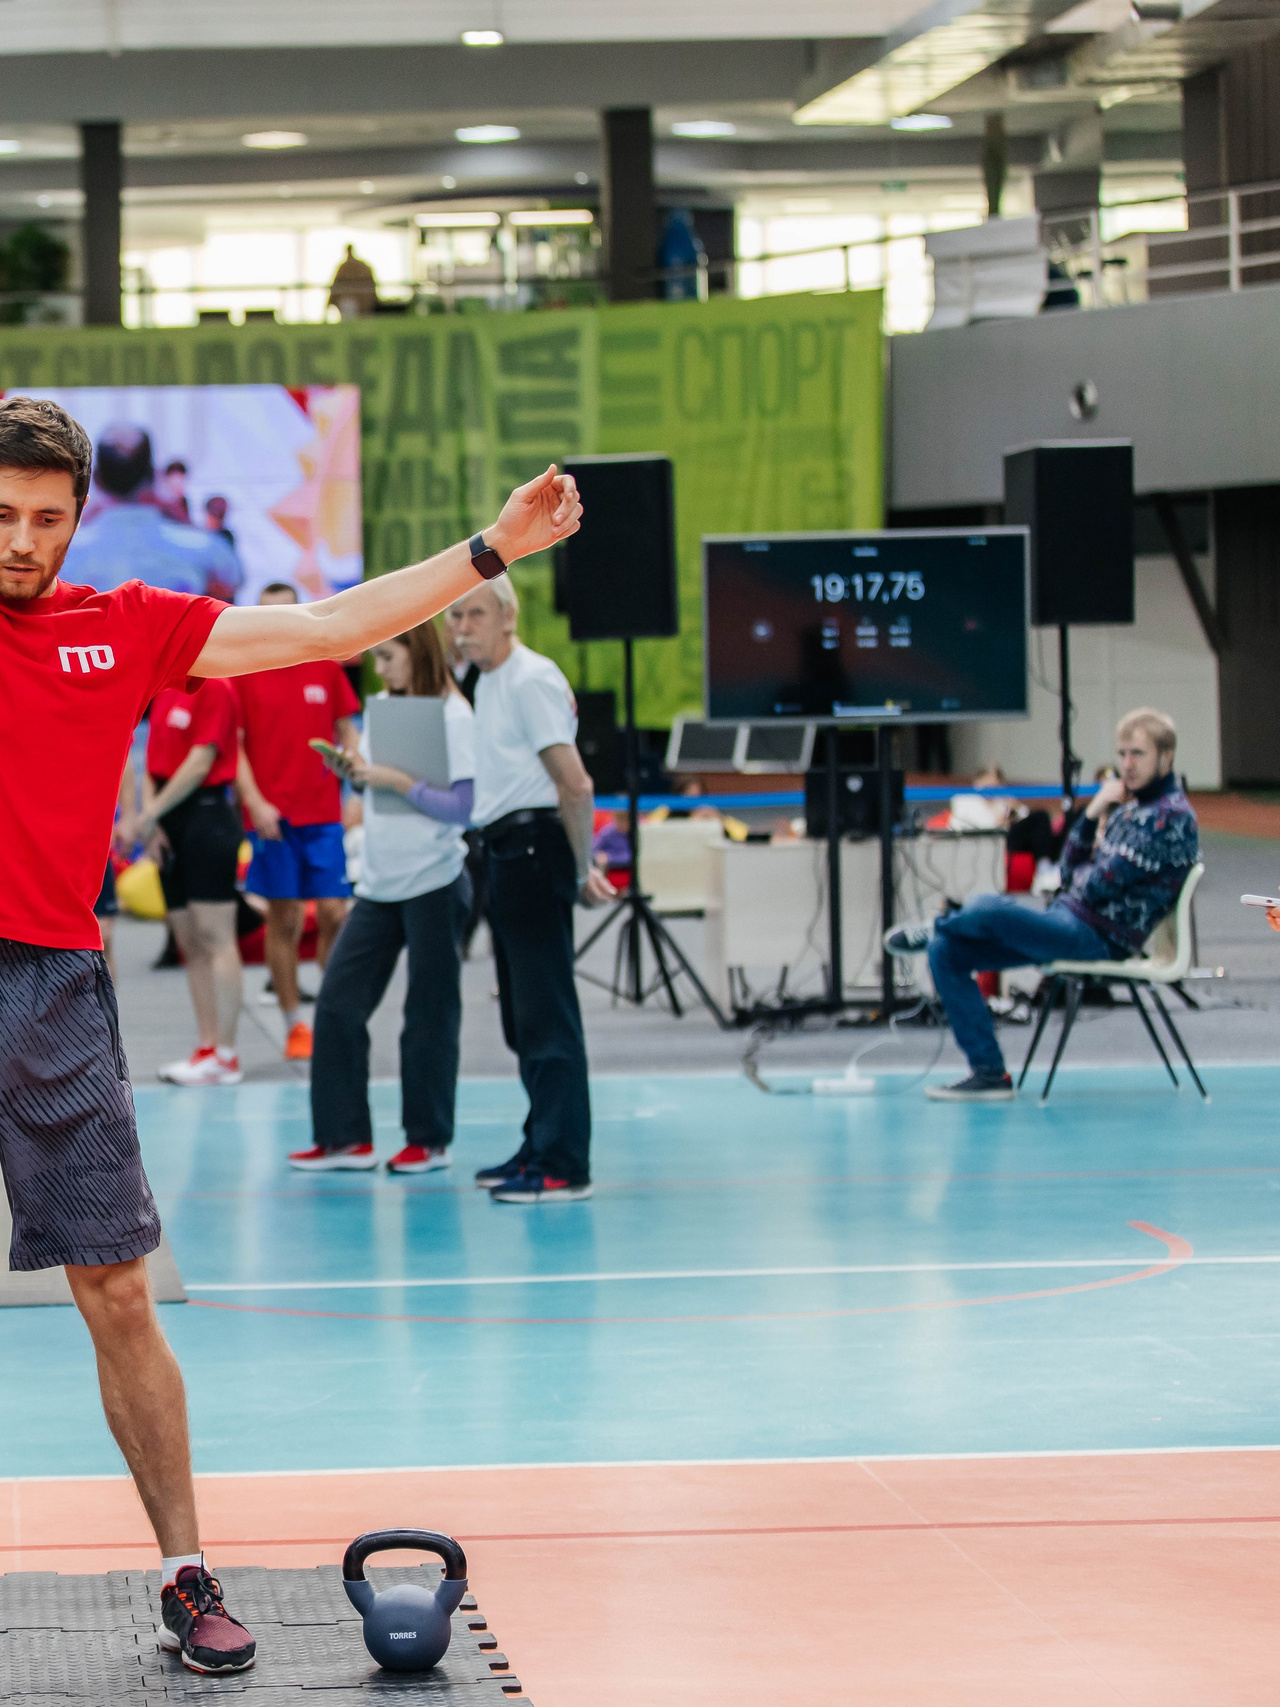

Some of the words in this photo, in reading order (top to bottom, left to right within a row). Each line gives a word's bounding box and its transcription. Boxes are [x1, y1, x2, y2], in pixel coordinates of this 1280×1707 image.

[674, 316, 858, 422] СПОРТ
[810, 571, 926, 604] 19:17,75
[58, 645, 115, 673] ГТО
[389, 1632, 417, 1640] TORRES
